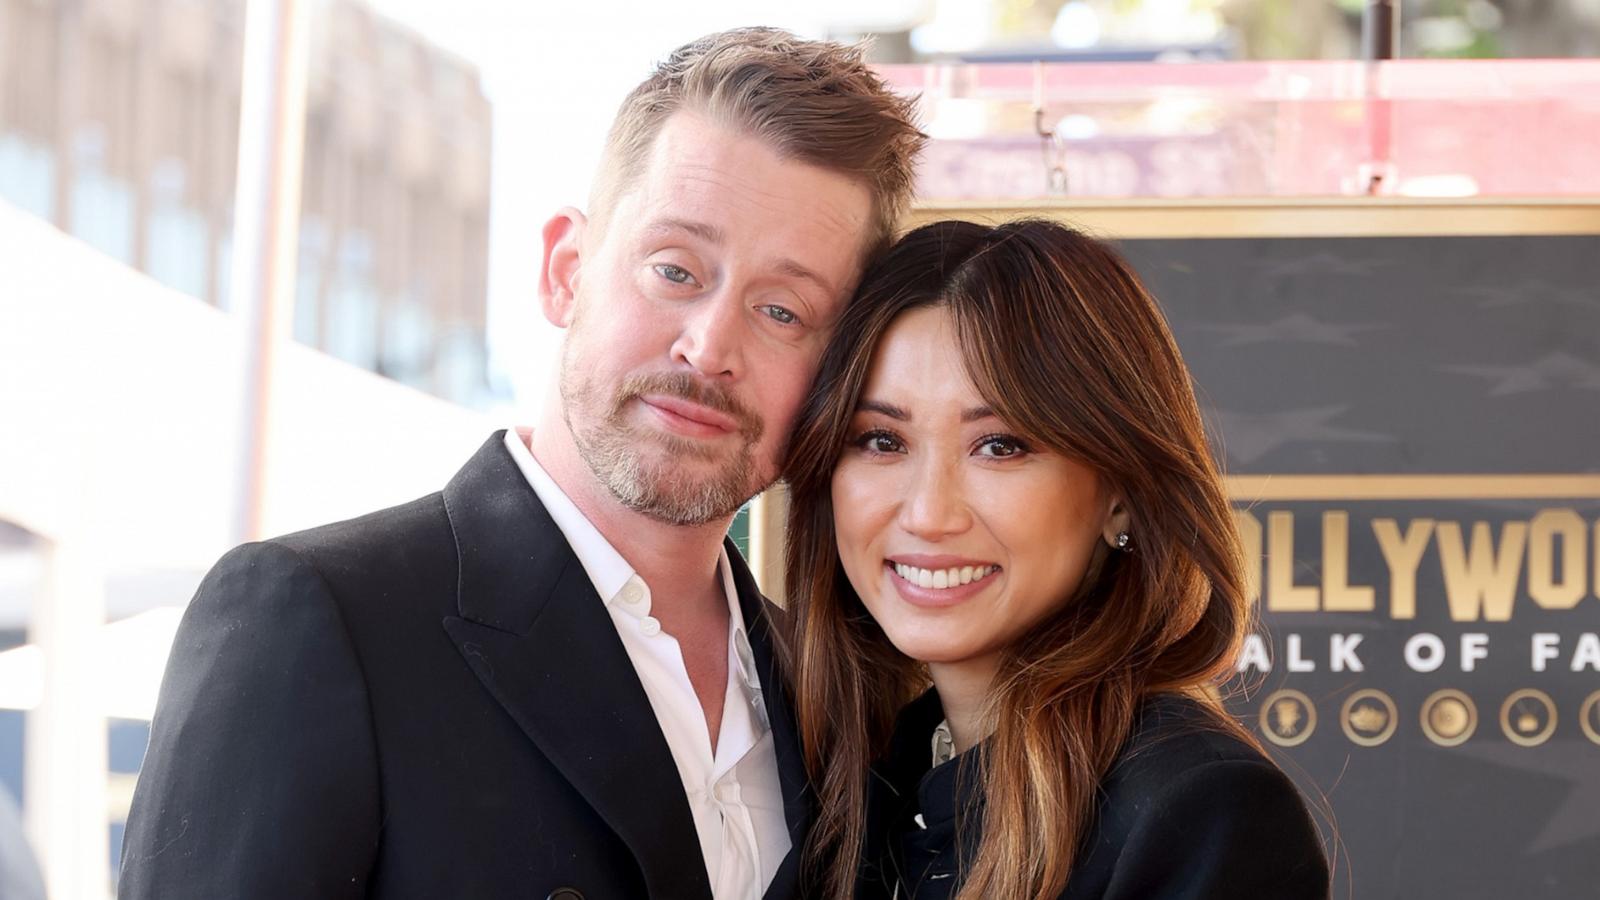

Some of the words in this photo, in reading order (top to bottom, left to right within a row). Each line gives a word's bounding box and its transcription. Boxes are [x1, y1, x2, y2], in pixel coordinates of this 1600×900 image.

[1231, 508, 1600, 622] LLYWO
[1236, 632, 1365, 673] ALK
[1403, 632, 1490, 673] OF
